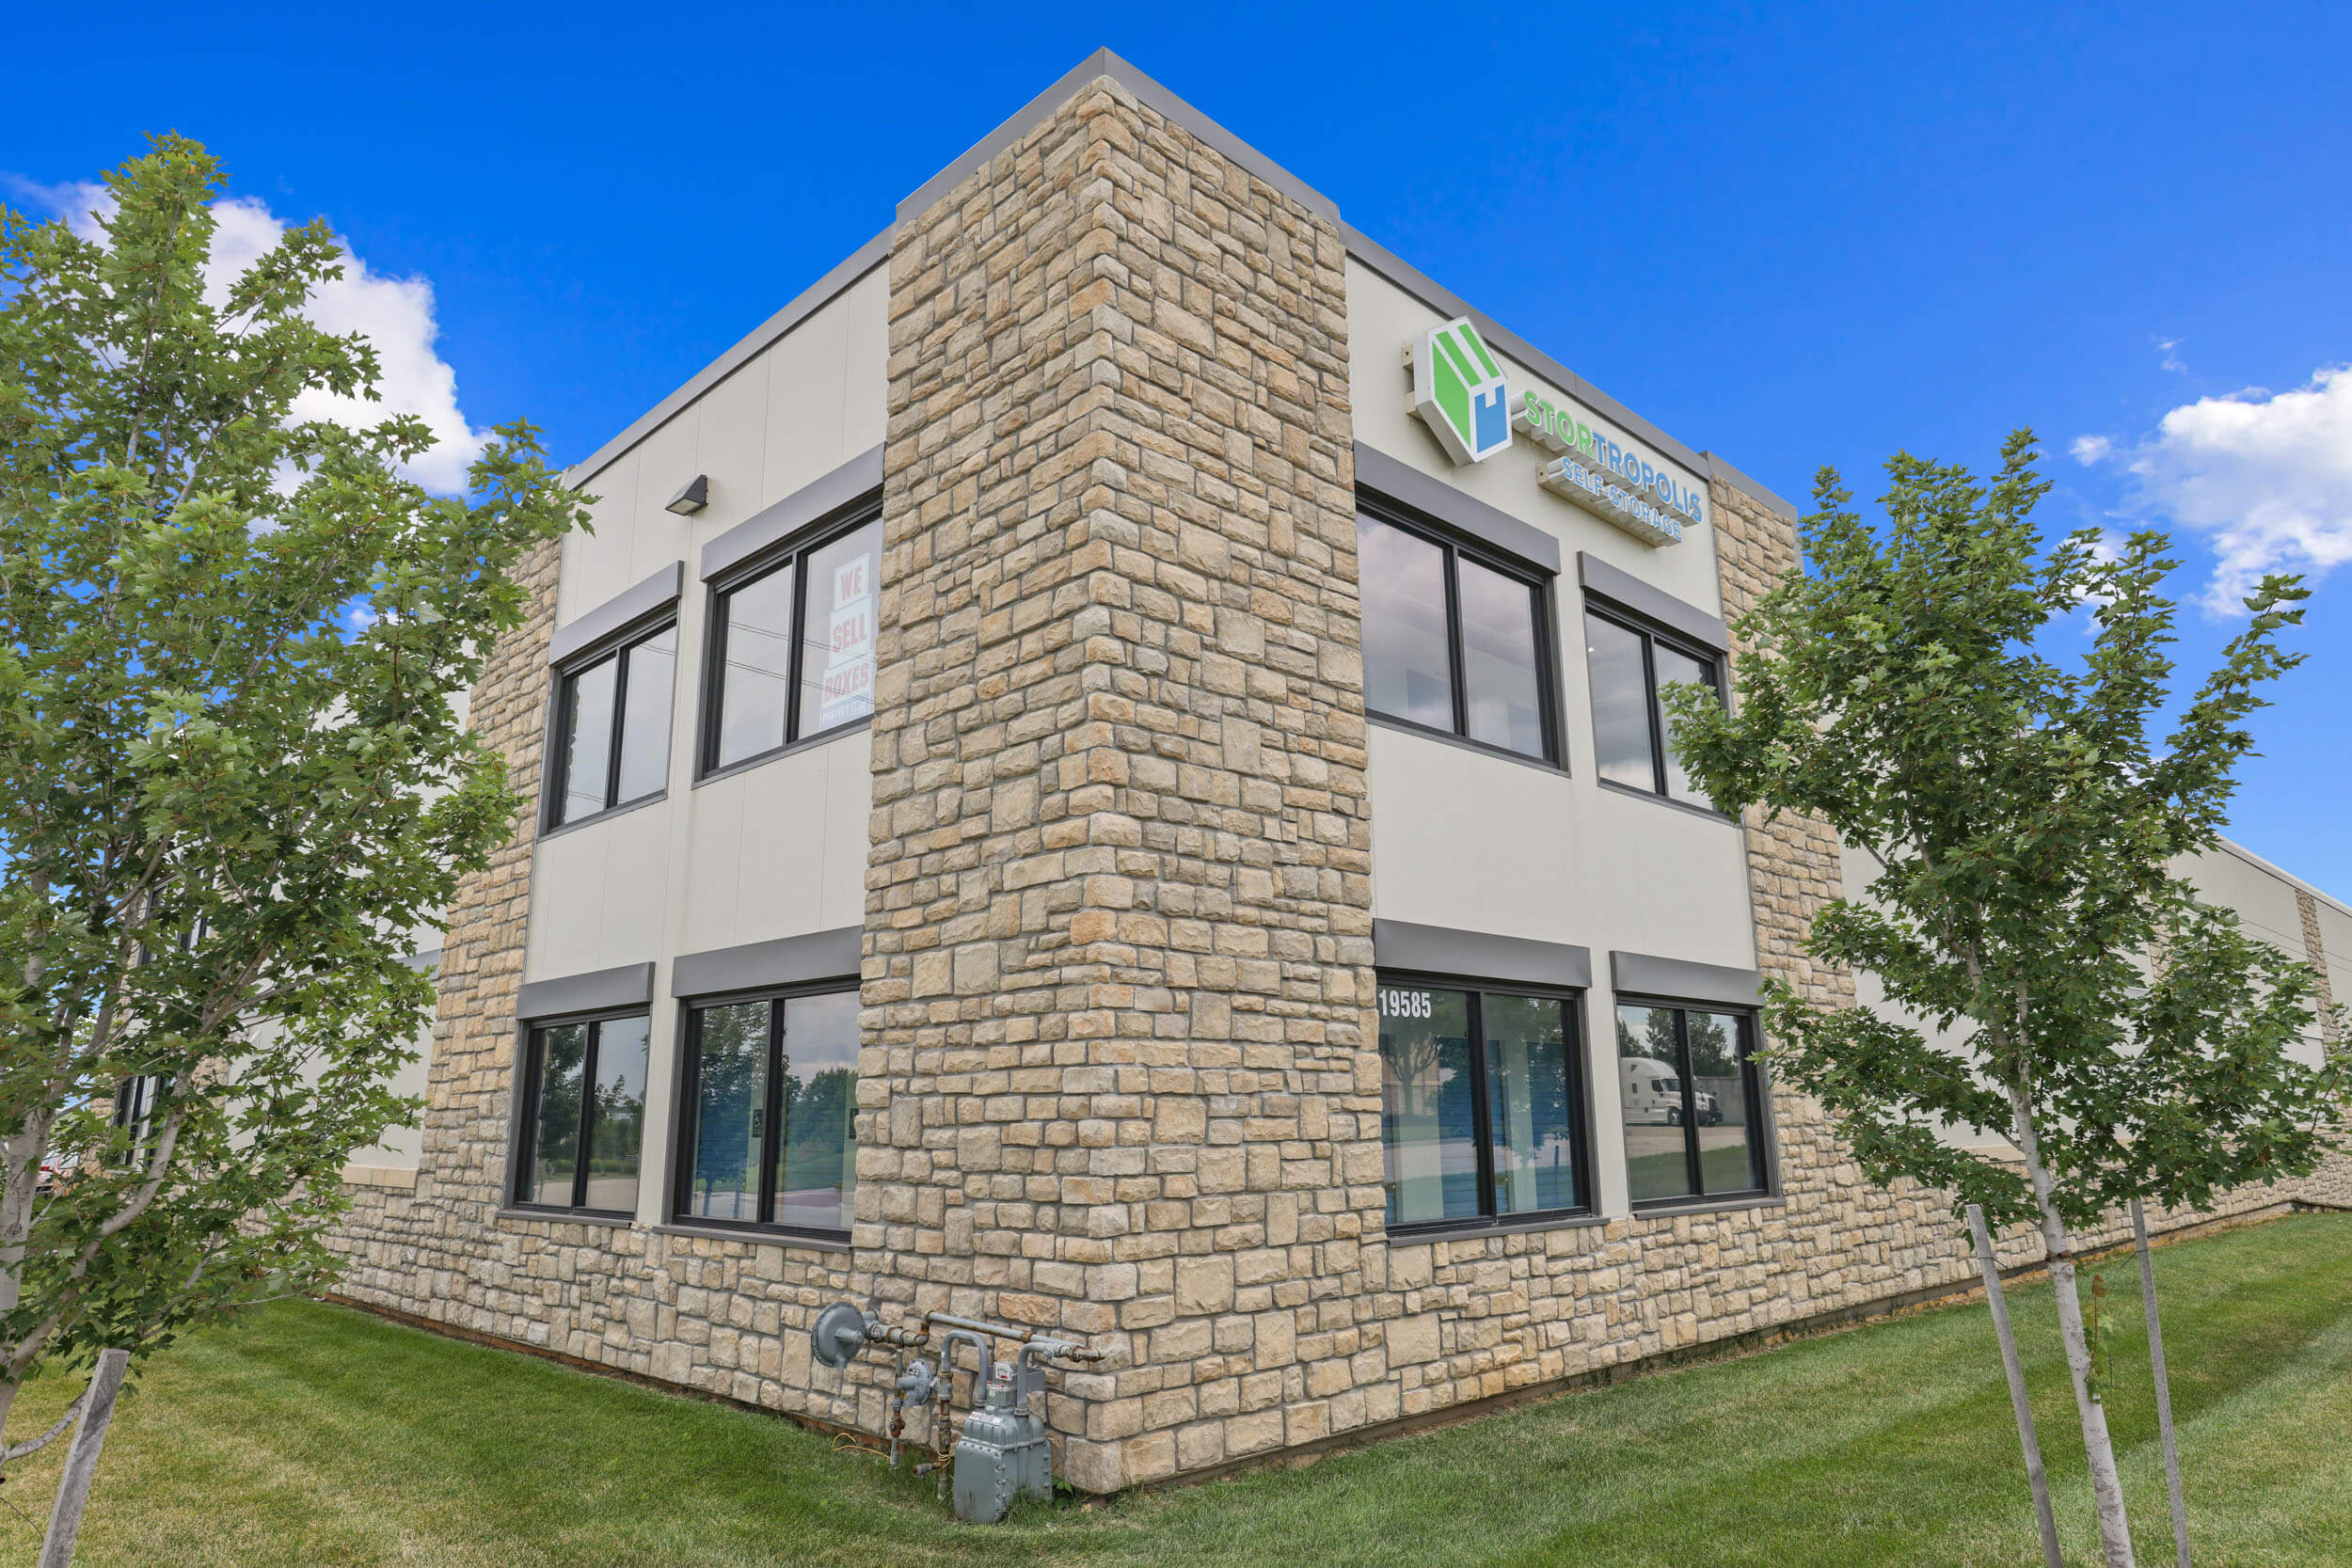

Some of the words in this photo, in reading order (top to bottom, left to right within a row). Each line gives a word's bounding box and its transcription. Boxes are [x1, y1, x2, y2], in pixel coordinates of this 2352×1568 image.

[1524, 390, 1703, 524] STORTROPOLIS
[1563, 456, 1683, 542] SELF-STORAGE
[839, 565, 863, 601] WE
[832, 612, 867, 653] SELL
[824, 661, 869, 702] BOXES
[1378, 989, 1432, 1019] 19585
